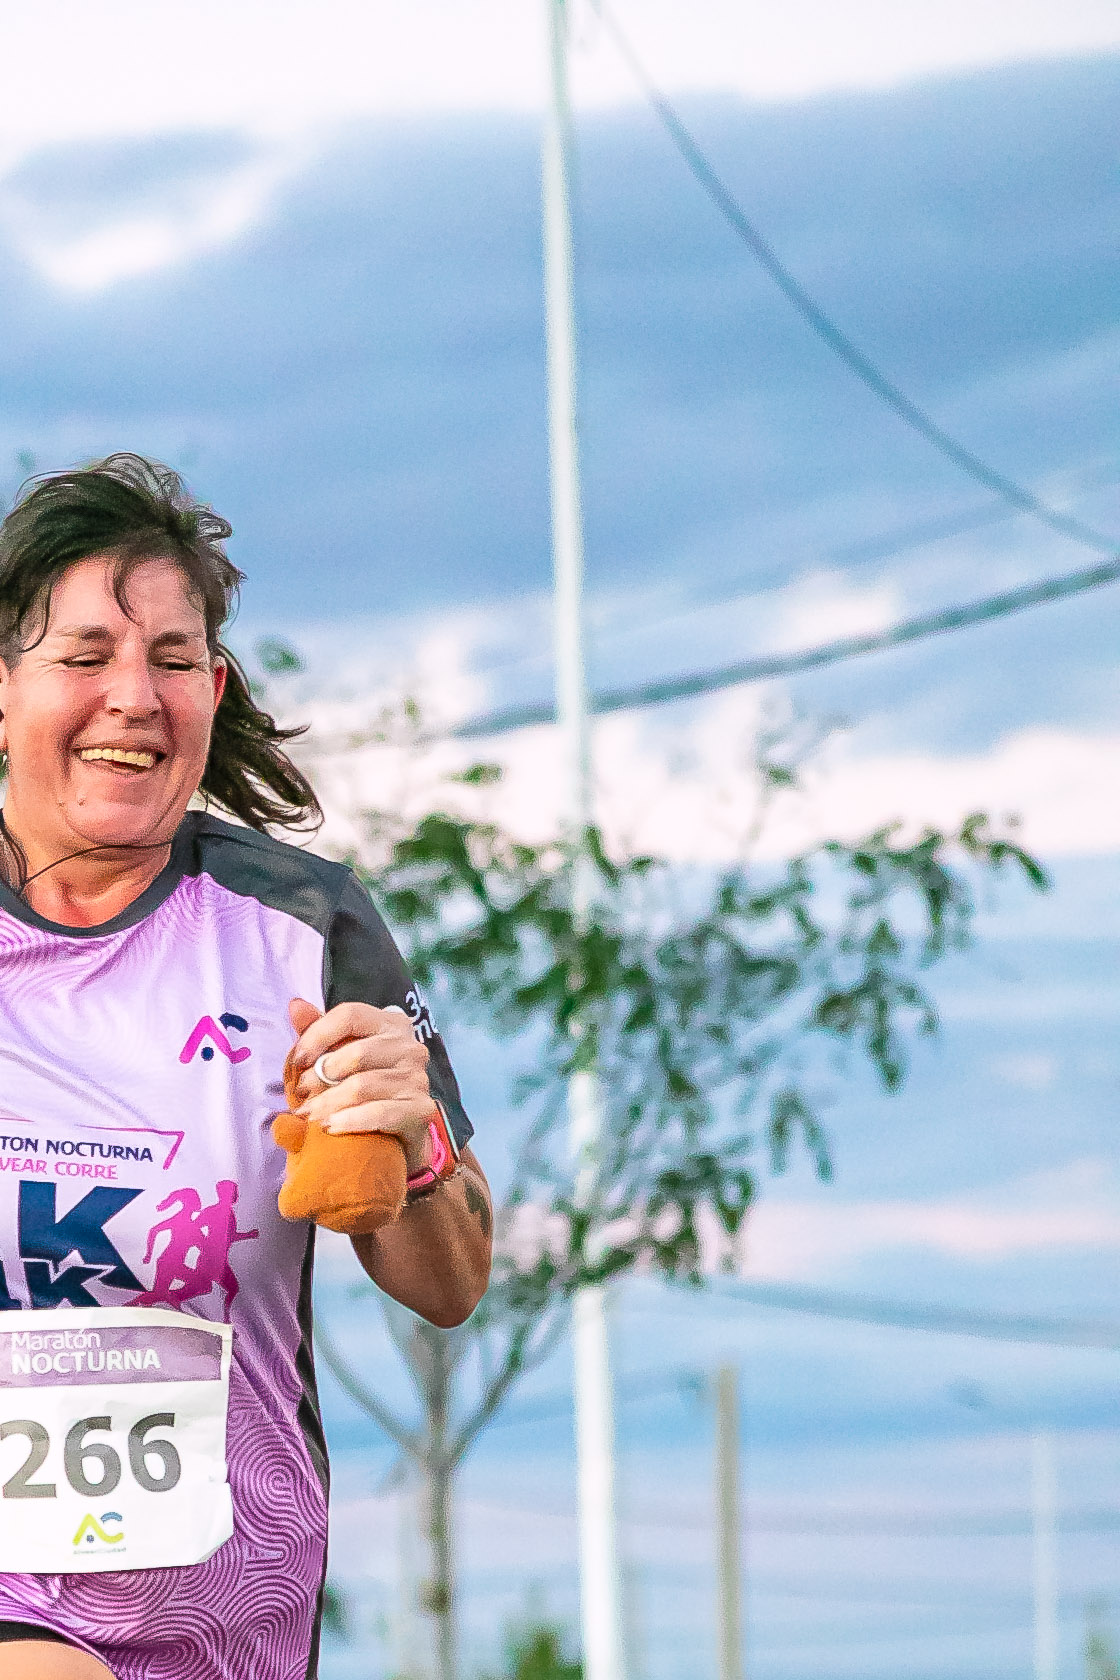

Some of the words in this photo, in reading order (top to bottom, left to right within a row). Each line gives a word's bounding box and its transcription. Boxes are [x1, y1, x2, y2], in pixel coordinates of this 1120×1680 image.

[46, 1138, 154, 1163] NOCTURNA
[54, 1160, 119, 1180] CORRE
[10, 1328, 101, 1351] Maratón
[10, 1348, 162, 1375] NOCTURNA
[0, 1412, 182, 1499] 266
